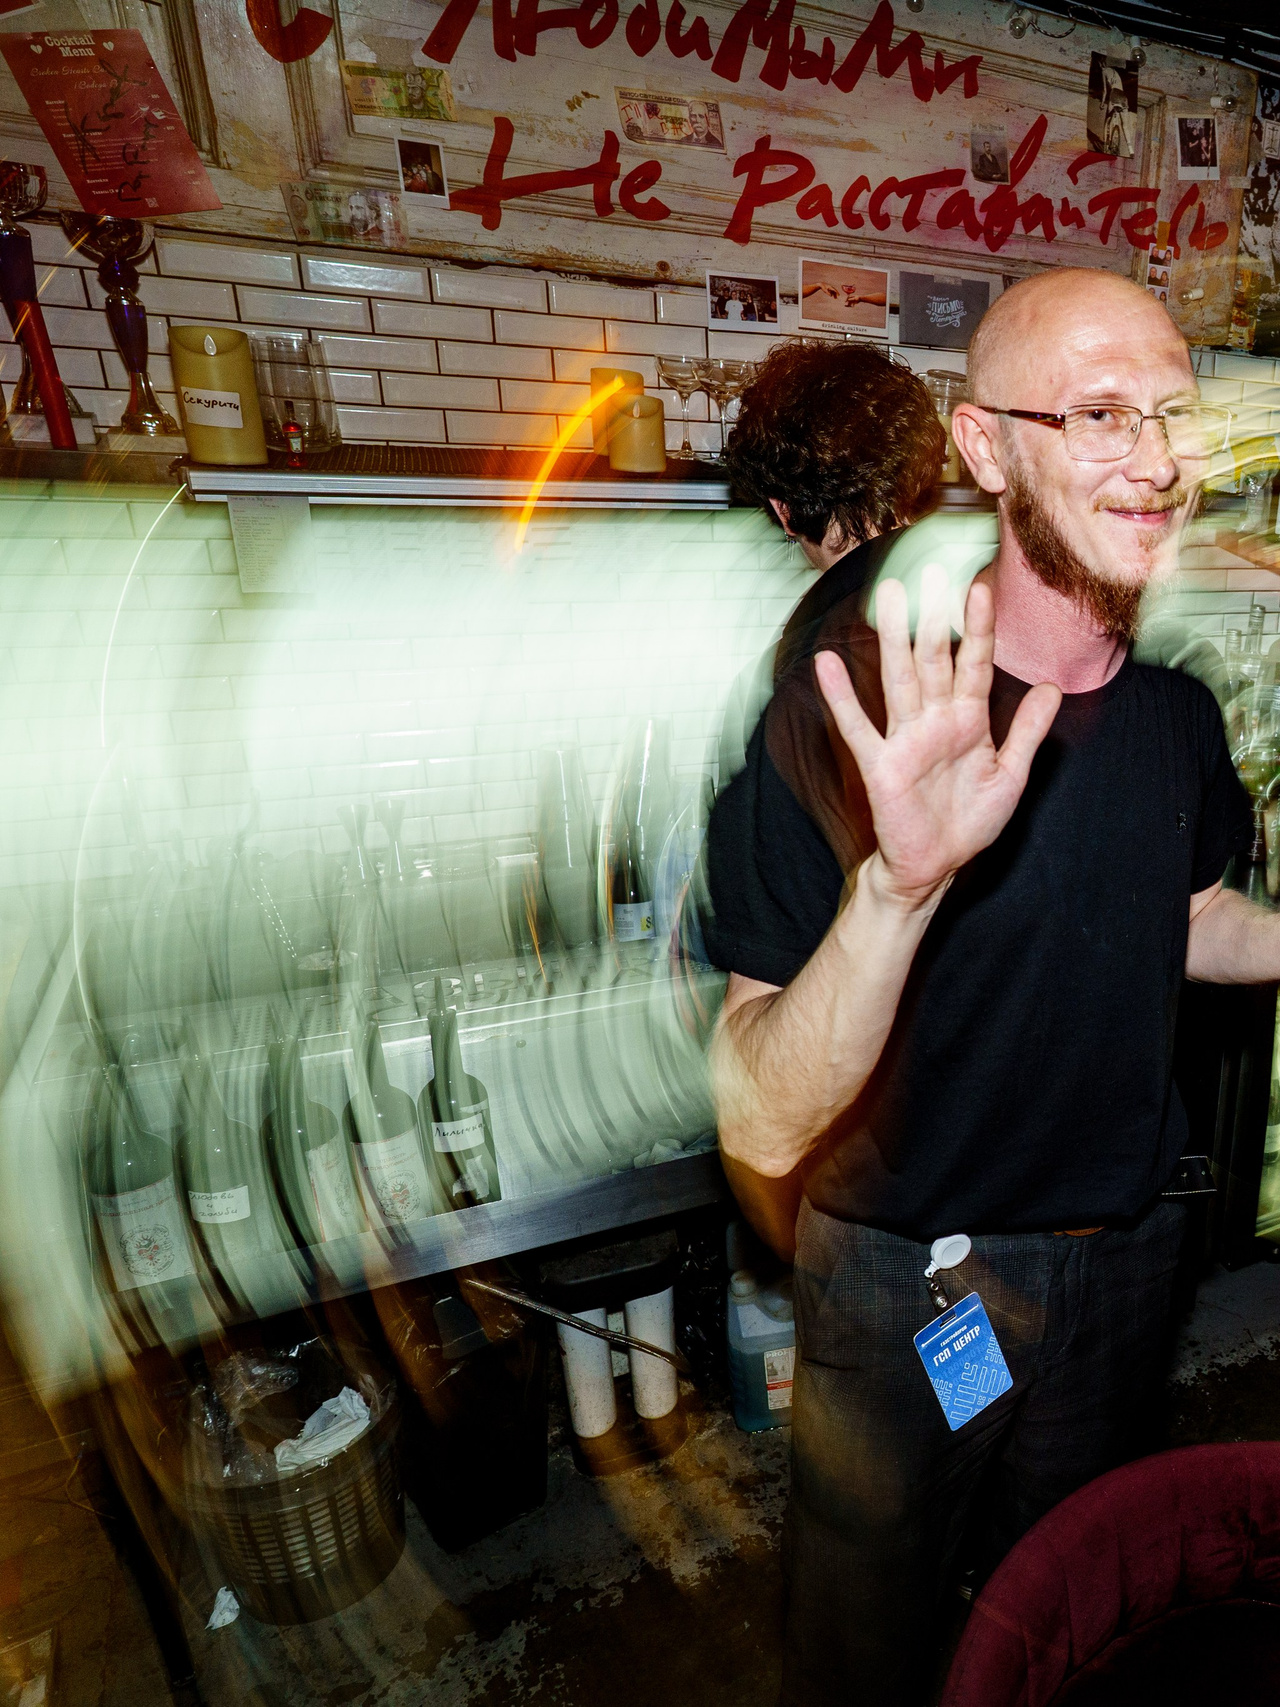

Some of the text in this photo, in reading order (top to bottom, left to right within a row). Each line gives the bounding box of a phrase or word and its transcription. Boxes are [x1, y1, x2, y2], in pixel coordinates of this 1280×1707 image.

[44, 35, 96, 47] Cocktail
[59, 46, 96, 57] Menu
[722, 115, 1229, 260] Расставайтесь
[931, 300, 961, 314] ПИСЬМО
[821, 323, 846, 331] drinking
[183, 391, 240, 411] Секурити
[198, 1207, 238, 1217] голуби
[933, 1325, 980, 1367] ГСП ЦЕНТР
